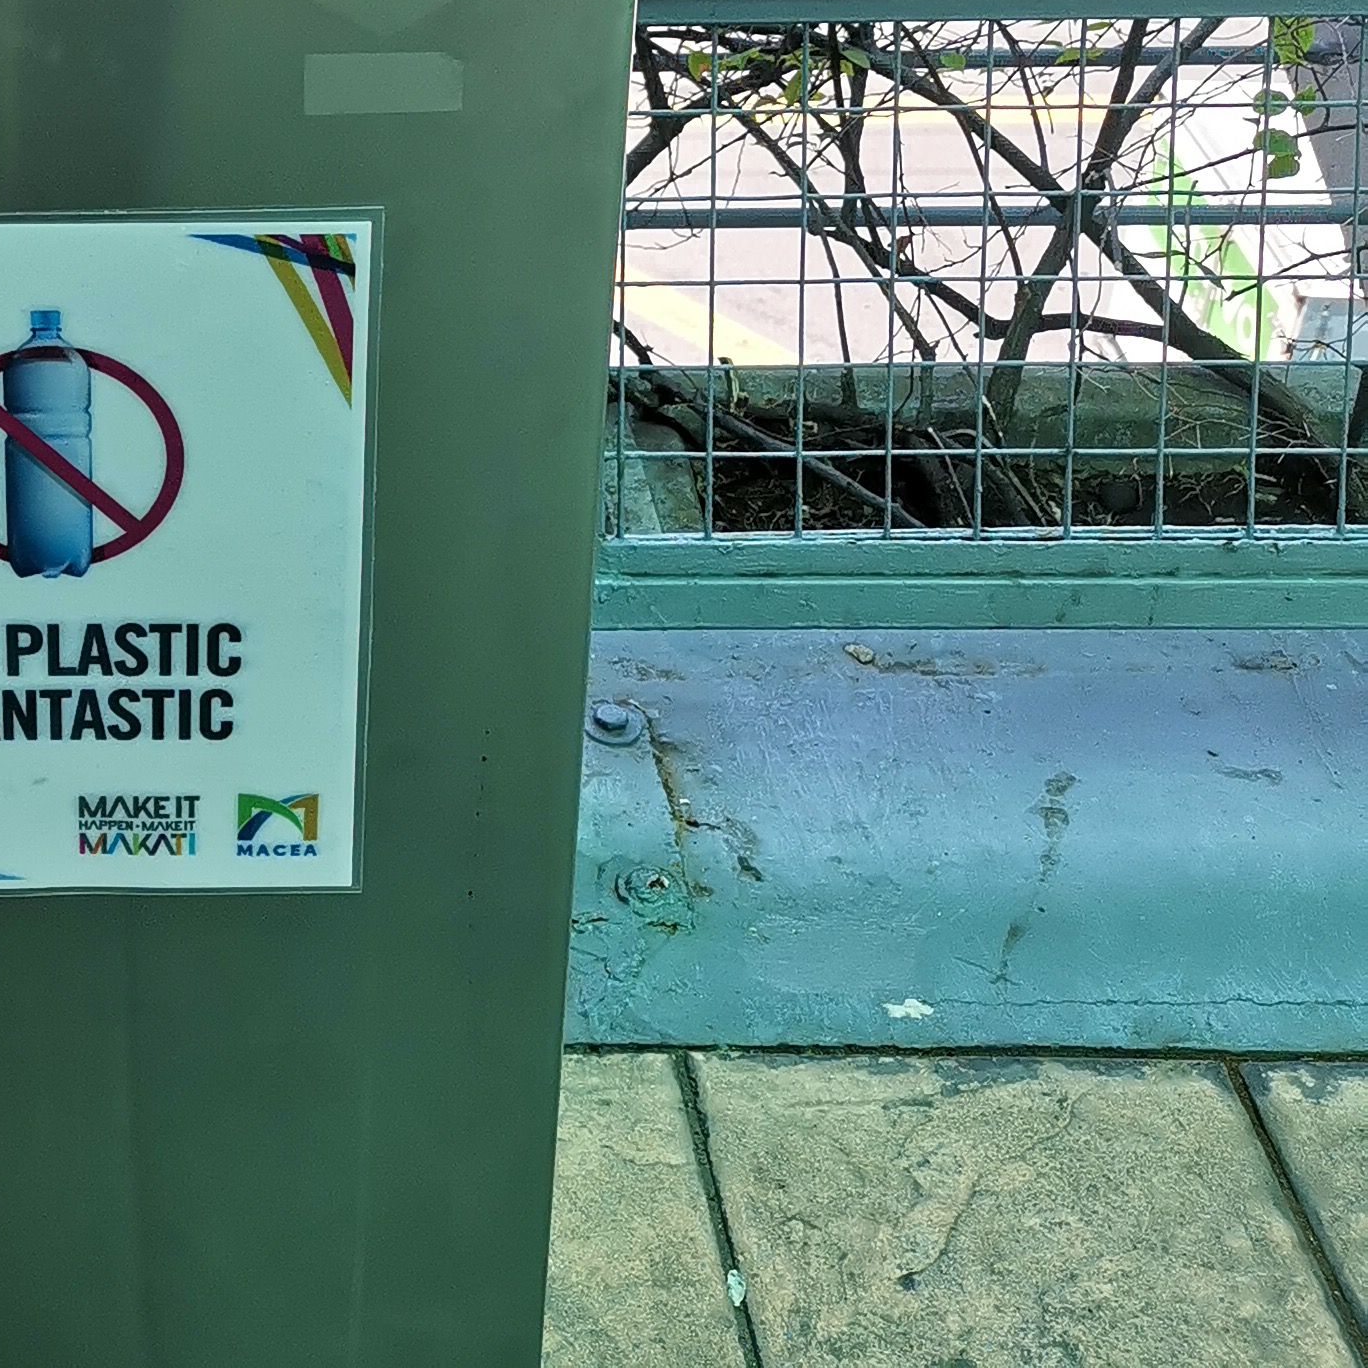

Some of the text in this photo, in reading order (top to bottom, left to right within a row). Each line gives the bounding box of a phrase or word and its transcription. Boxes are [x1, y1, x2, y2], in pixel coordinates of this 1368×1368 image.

[5, 623, 242, 677] PLASTIC
[78, 795, 201, 819] MAKE IT
[79, 820, 197, 831] HAPPEN MAKE IT
[78, 832, 197, 856] MAKATI
[236, 843, 318, 857] MACEA
